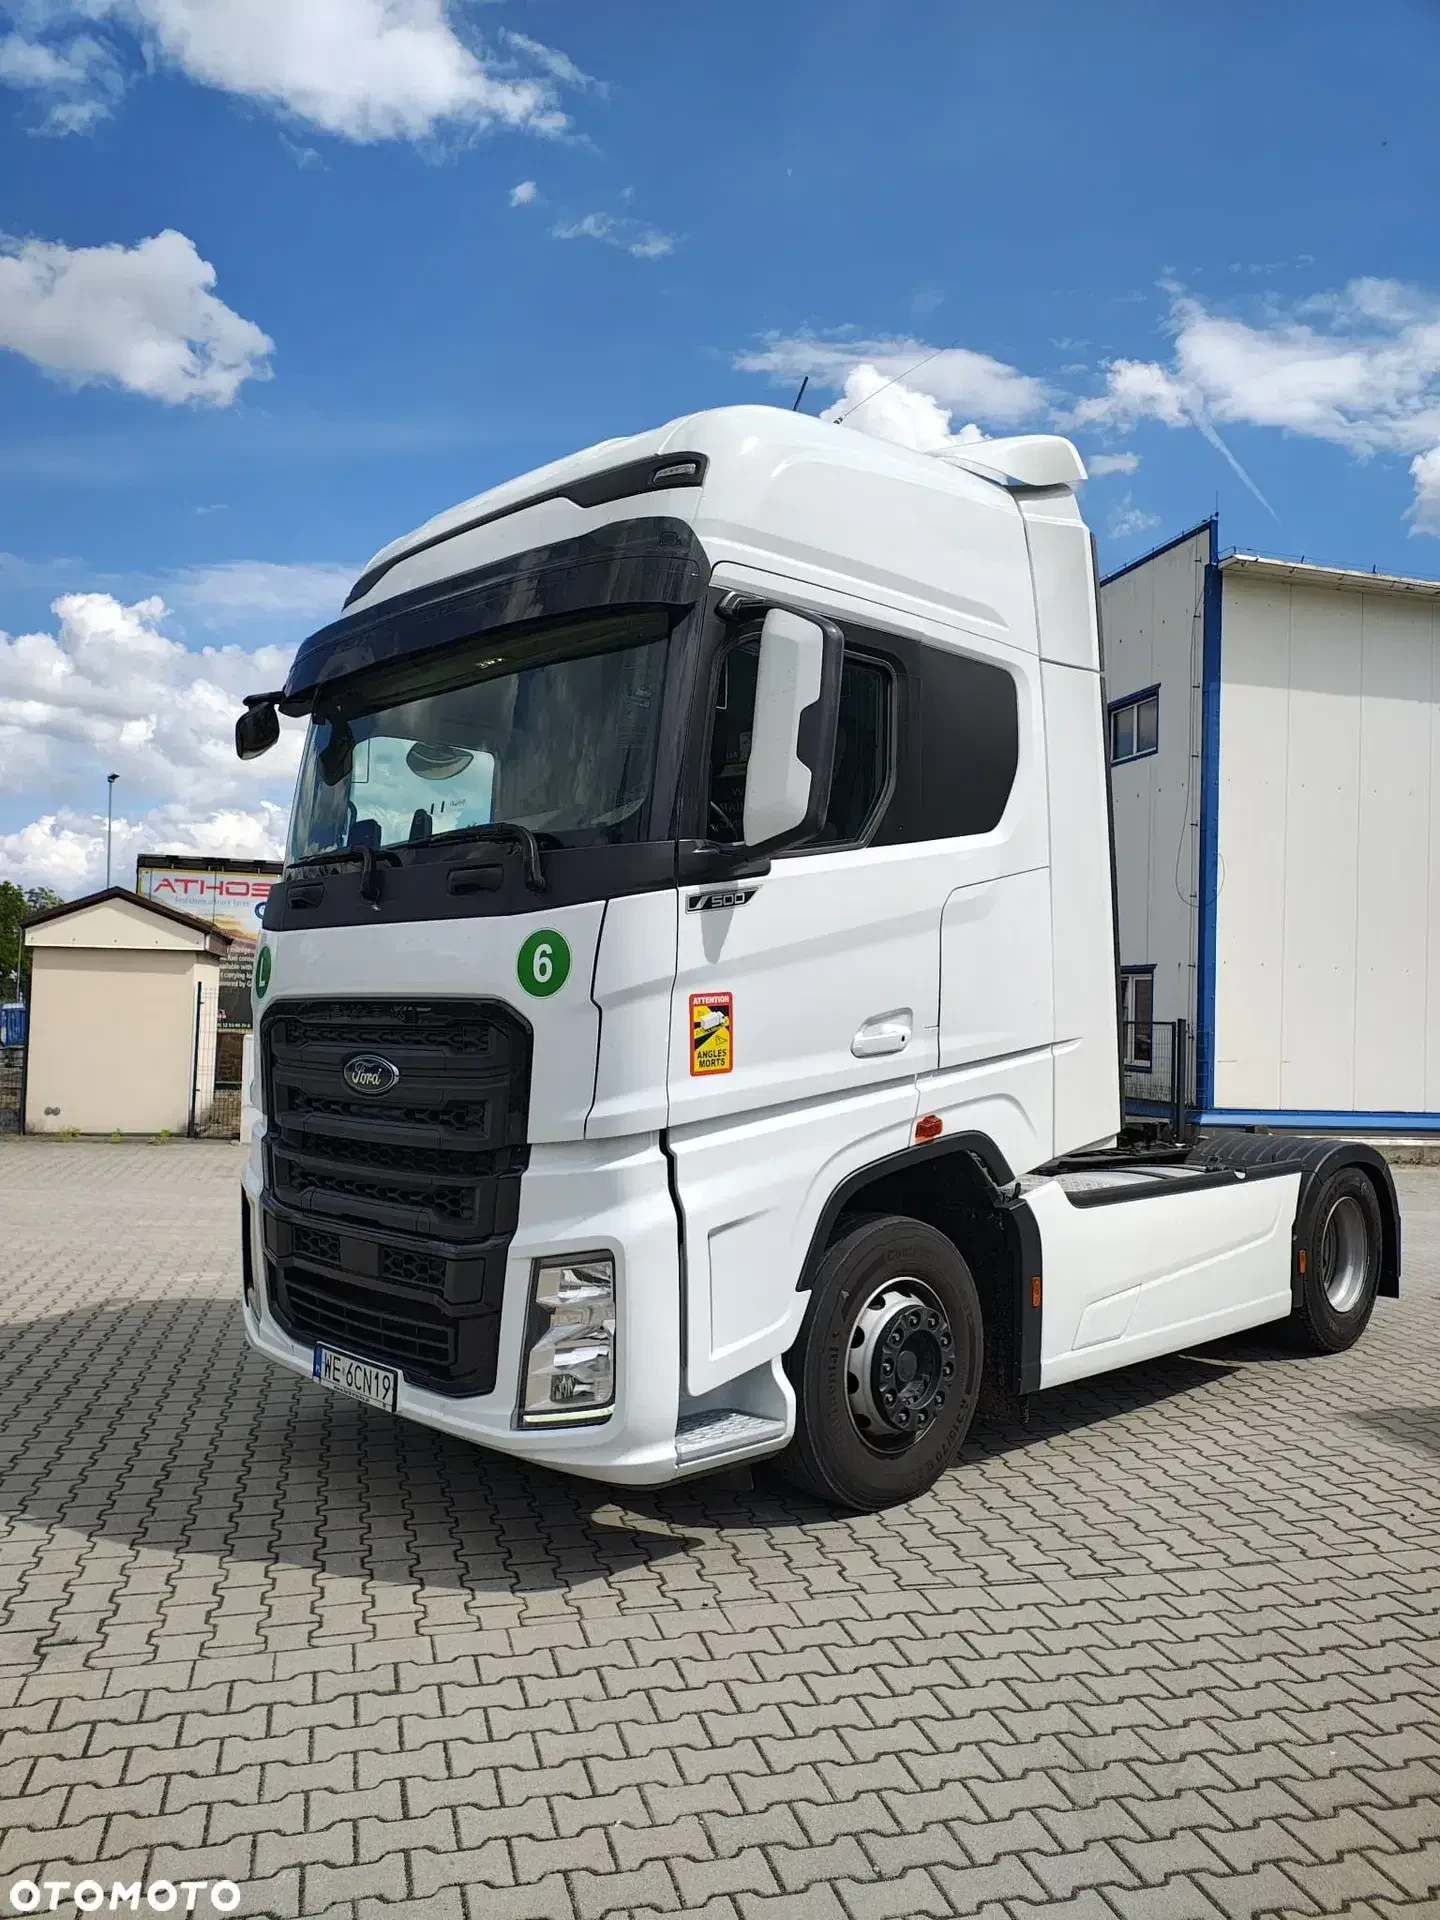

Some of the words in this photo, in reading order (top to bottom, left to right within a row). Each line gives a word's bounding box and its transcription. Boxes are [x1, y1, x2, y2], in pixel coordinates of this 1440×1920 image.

[154, 878, 270, 897] ATHOS
[711, 893, 745, 908] 500
[259, 957, 266, 988] L
[532, 943, 554, 983] 6
[693, 995, 730, 1005] ATTENTION
[697, 1048, 727, 1060] ANGLES
[698, 1058, 726, 1069] MORTS
[351, 1061, 382, 1086] Ford
[324, 1352, 341, 1383] WE
[346, 1362, 391, 1400] 6CN19
